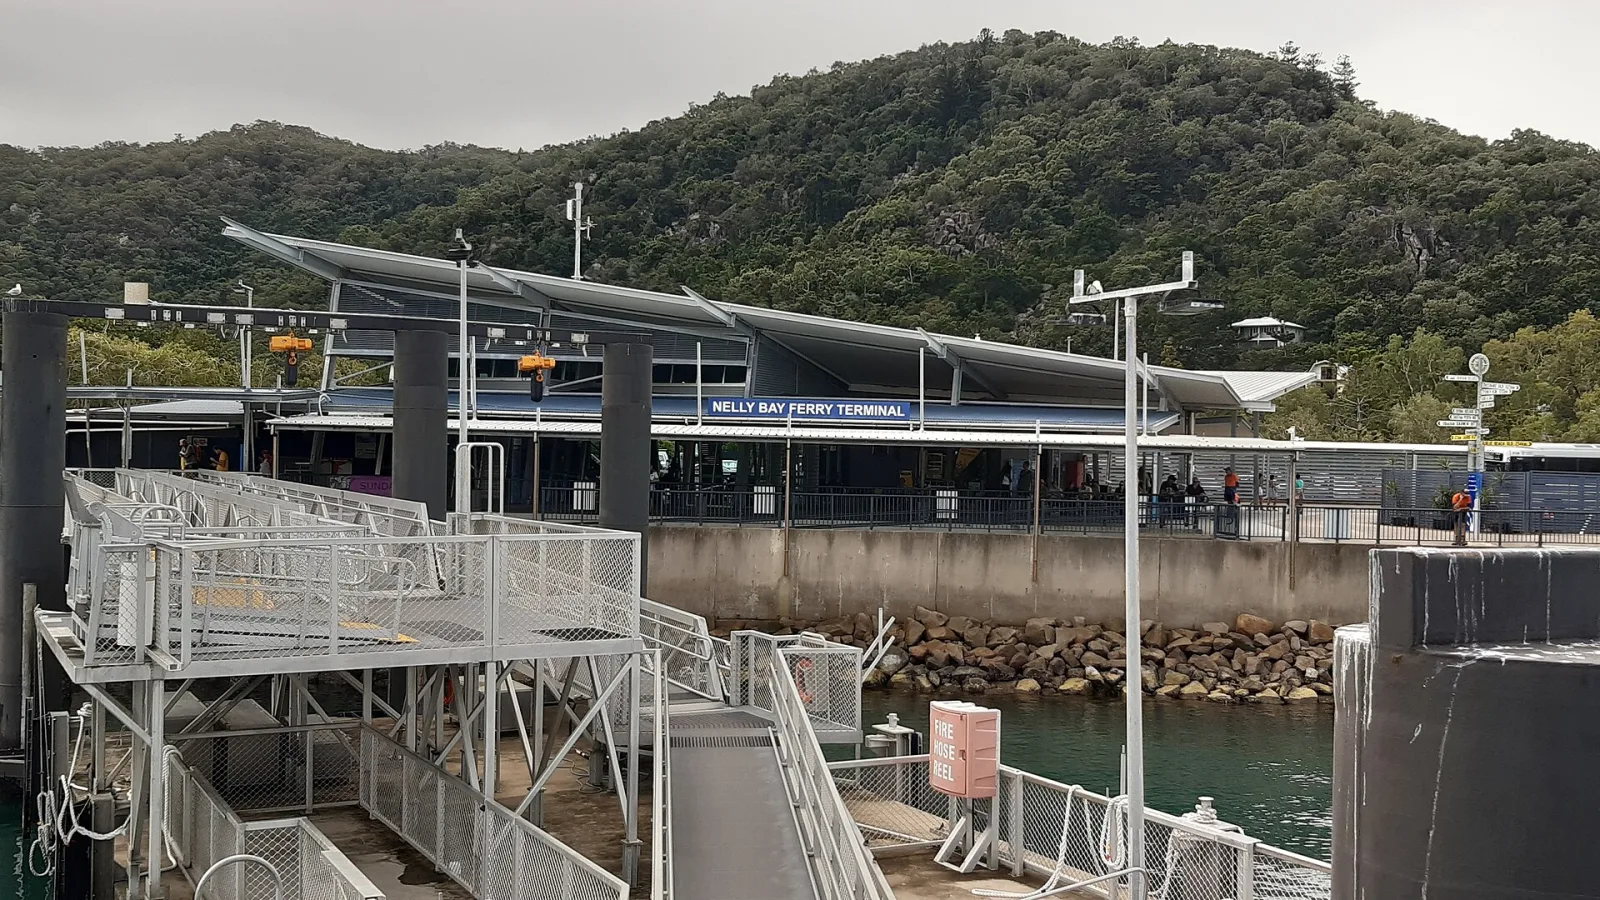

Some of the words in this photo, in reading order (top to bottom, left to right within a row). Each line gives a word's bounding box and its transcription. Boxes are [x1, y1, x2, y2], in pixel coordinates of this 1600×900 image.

[712, 401, 755, 413] NELLY
[758, 402, 786, 414] BAY
[789, 402, 833, 416] FERRY
[836, 404, 906, 417] TERMINAL
[934, 719, 953, 740] FIRE
[934, 739, 955, 760] HOSE
[933, 760, 954, 781] REEL
